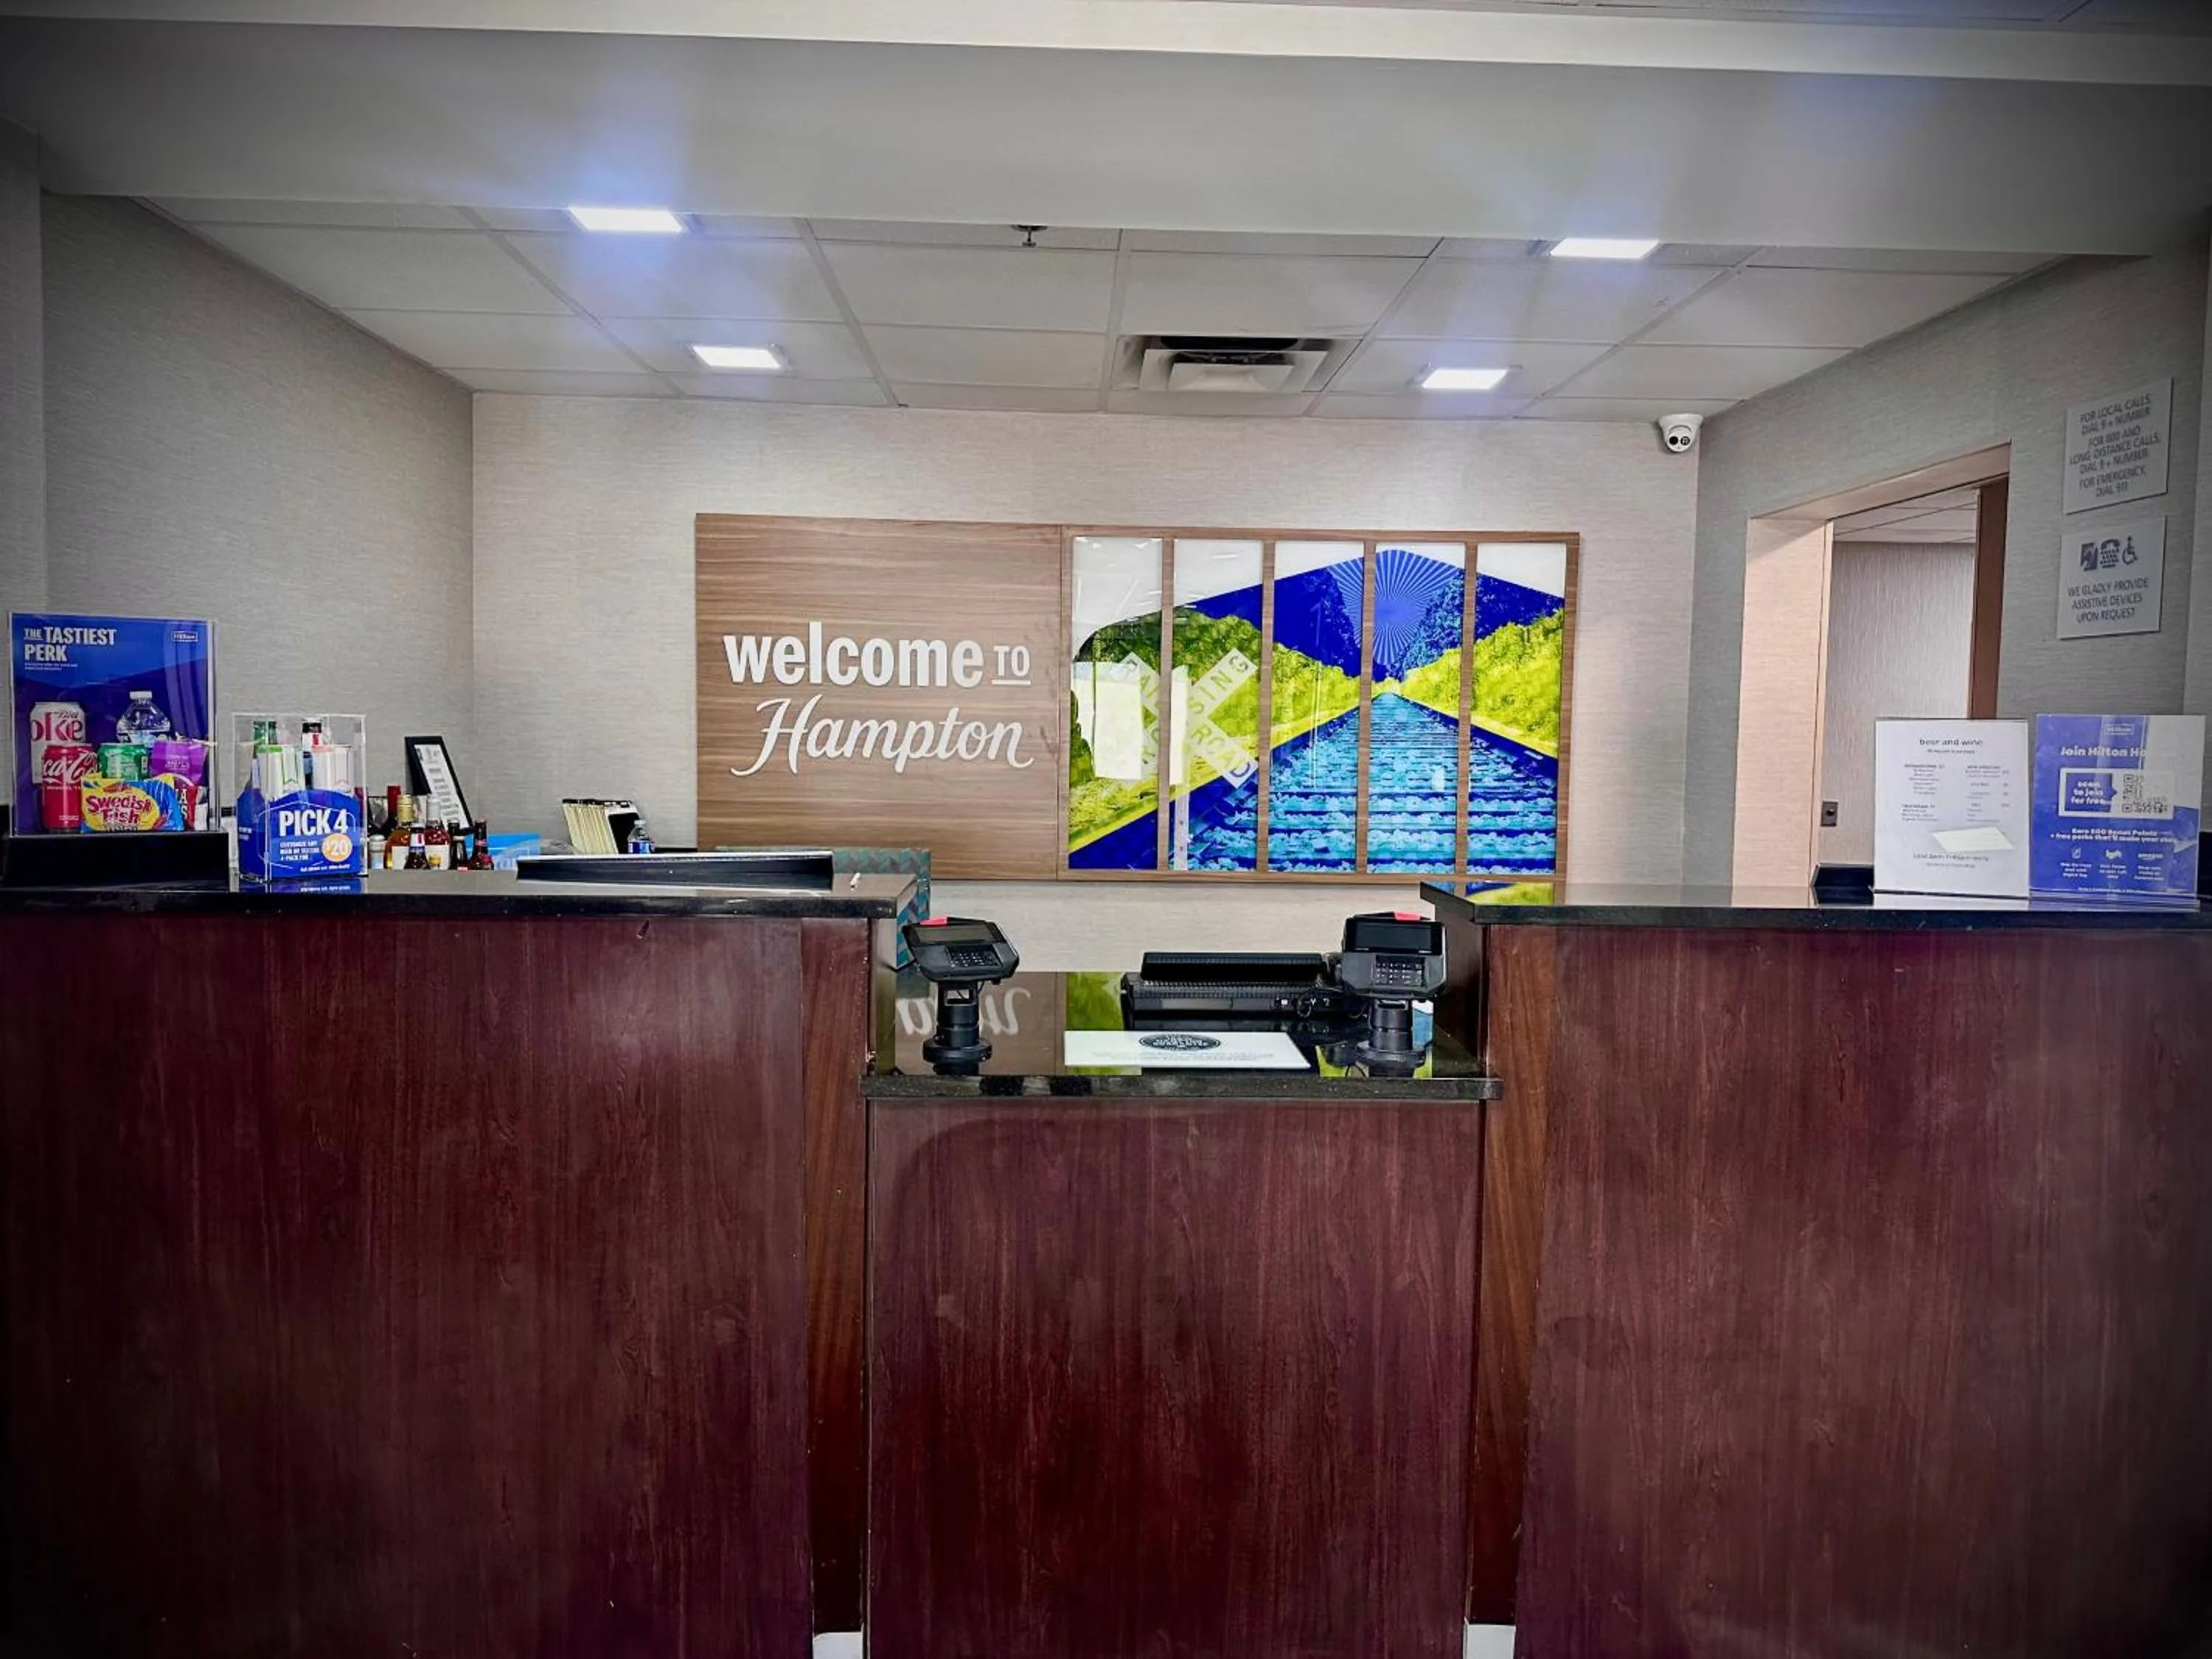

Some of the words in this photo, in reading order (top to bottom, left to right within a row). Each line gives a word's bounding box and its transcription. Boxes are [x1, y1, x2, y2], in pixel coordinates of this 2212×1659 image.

[2080, 411, 2096, 422] FOR
[2098, 403, 2122, 419] LOCAL
[2081, 420, 2098, 436] DIAL
[2115, 406, 2150, 425] NUMBER
[2123, 425, 2140, 438] AND
[2093, 440, 2132, 459] DISTANCE
[2112, 448, 2148, 465] NUMBER
[2067, 586, 2081, 597] WE
[2081, 582, 2112, 595] GLADLY
[2114, 577, 2149, 591] PROVIDE
[2072, 595, 2109, 610] ASSISTIVE
[2110, 591, 2143, 606] DEVICES
[2076, 611, 2100, 623] UPON
[2101, 607, 2135, 621] REQUEST
[24, 627, 43, 641] THE
[44, 626, 116, 646] TASTIEST
[24, 644, 67, 662] PERK
[723, 621, 984, 689] welcome
[992, 644, 1032, 685] TO
[731, 693, 1034, 777] Hampton
[2061, 745, 2086, 757] Join
[2087, 746, 2127, 757] Hilton
[2070, 796, 2085, 804] for
[2084, 788, 2103, 796] join
[86, 795, 153, 813] Swedish
[101, 809, 140, 824] Fish
[279, 808, 332, 837] PICK
[333, 808, 349, 835] 4
[2105, 849, 2123, 860] lyft
